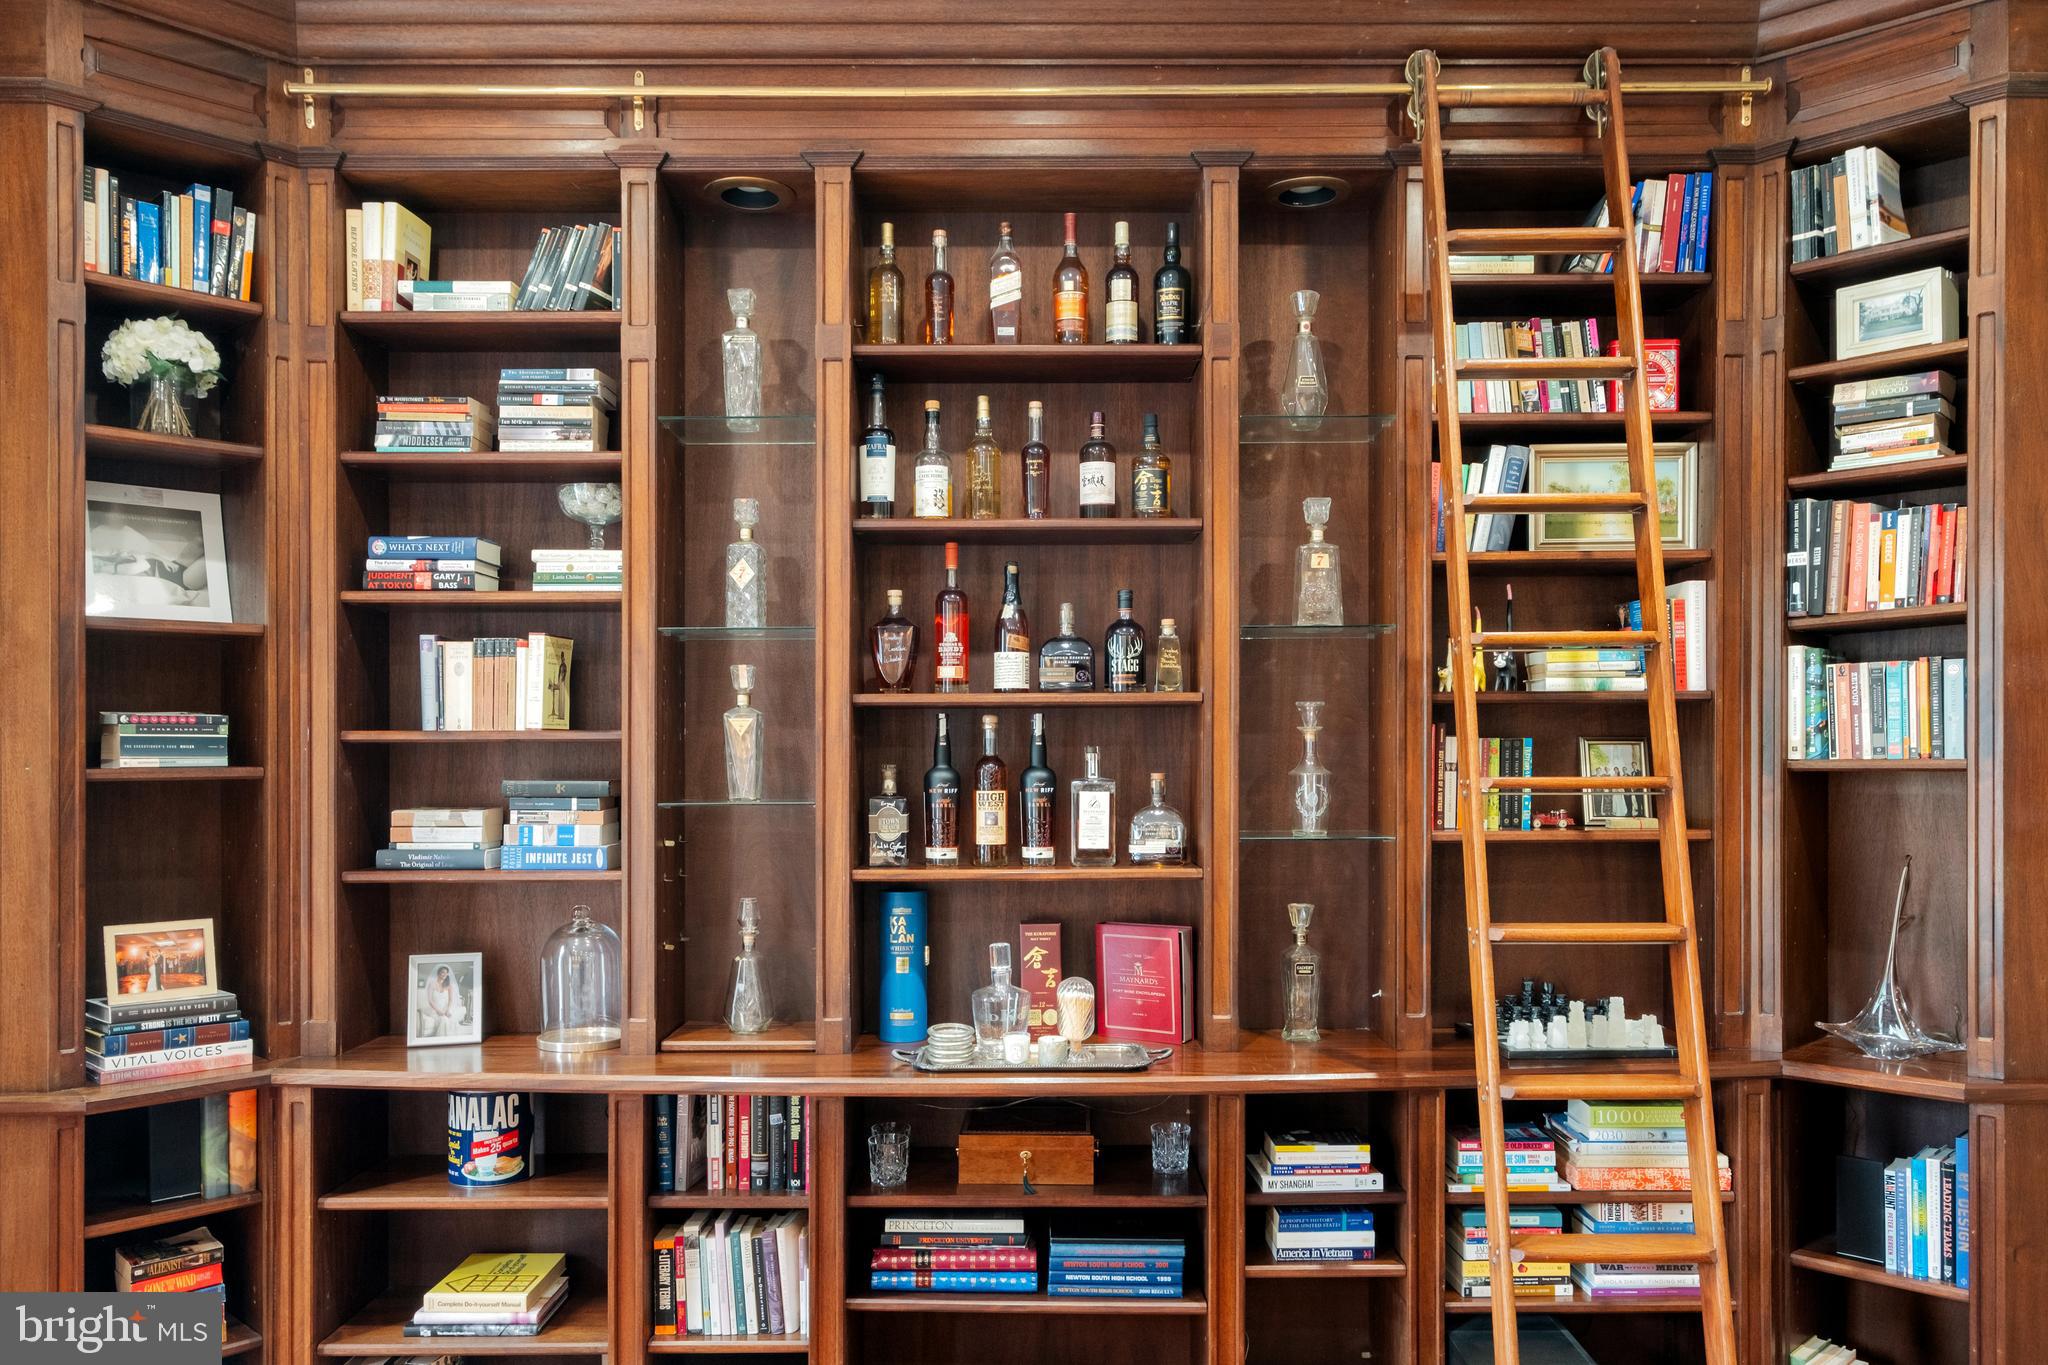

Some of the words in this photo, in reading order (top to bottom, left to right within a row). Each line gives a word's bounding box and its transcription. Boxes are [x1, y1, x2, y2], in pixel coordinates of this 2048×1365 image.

[1835, 503, 1843, 520] PHILIP
[1834, 520, 1842, 534] ROTH
[1833, 534, 1841, 543] THE
[389, 543, 423, 552] WHAT'S
[425, 543, 450, 552] NEXT
[1855, 533, 1863, 571] ROWLING
[1884, 533, 1894, 564] GREECE
[1111, 659, 1139, 672] STAGG
[1808, 713, 1816, 745] Everywhere
[978, 793, 1004, 801] HIGH
[525, 853, 568, 864] INFINITE
[571, 853, 592, 864] JEST
[889, 916, 906, 926] KA
[890, 924, 906, 935] VA
[890, 933, 915, 944] LAN
[142, 1007, 167, 1015] HUMANS
[141, 1020, 165, 1030] STRONG
[173, 1018, 184, 1026] THE
[184, 1016, 198, 1025] NEW
[198, 1014, 221, 1024] PRETTY
[130, 1038, 162, 1047] HAMILTON
[112, 1054, 157, 1069] VITAL
[163, 1045, 223, 1062] VOICES
[757, 1108, 762, 1116] ON
[1597, 1109, 1645, 1124] 1000
[791, 1124, 800, 1140] Won
[1594, 1130, 1623, 1140] 2030
[472, 1147, 490, 1155] Makes
[490, 1141, 502, 1153] 25
[1510, 1142, 1522, 1150] OLD
[1462, 1154, 1478, 1165] EAGLE
[1514, 1154, 1526, 1164] SUN
[1268, 1181, 1278, 1189] MY
[1279, 1180, 1314, 1189] SHANGHAI
[1958, 1172, 1969, 1193] BY
[1885, 1174, 1895, 1211] MANHUNT
[1943, 1177, 1953, 1223] LEADING
[888, 1220, 954, 1232] PRINCETON
[1958, 1198, 1969, 1252] DESIGN
[1944, 1224, 1953, 1258] TEAMS
[1277, 1248, 1310, 1258] America
[1312, 1248, 1320, 1258] in
[1320, 1248, 1353, 1257] Vietnam
[149, 1258, 182, 1275] ALIENIST
[658, 1254, 671, 1286] LITERARY
[1063, 1261, 1087, 1269] NEWTON
[1088, 1261, 1107, 1269] SOUTH
[1108, 1261, 1122, 1269] HIGH
[1122, 1261, 1146, 1269] SCHOOL
[1154, 1261, 1169, 1269] 2001
[144, 1282, 167, 1293] GONE
[176, 1274, 196, 1289] WIND
[1065, 1274, 1087, 1282] NEWTON
[1087, 1274, 1108, 1282] SOUTH
[1110, 1274, 1124, 1282] HIGH
[1113, 1287, 1134, 1295] SCHOOL
[658, 1286, 671, 1310] TERMS
[464, 1301, 500, 1309] Do-it-yourself
